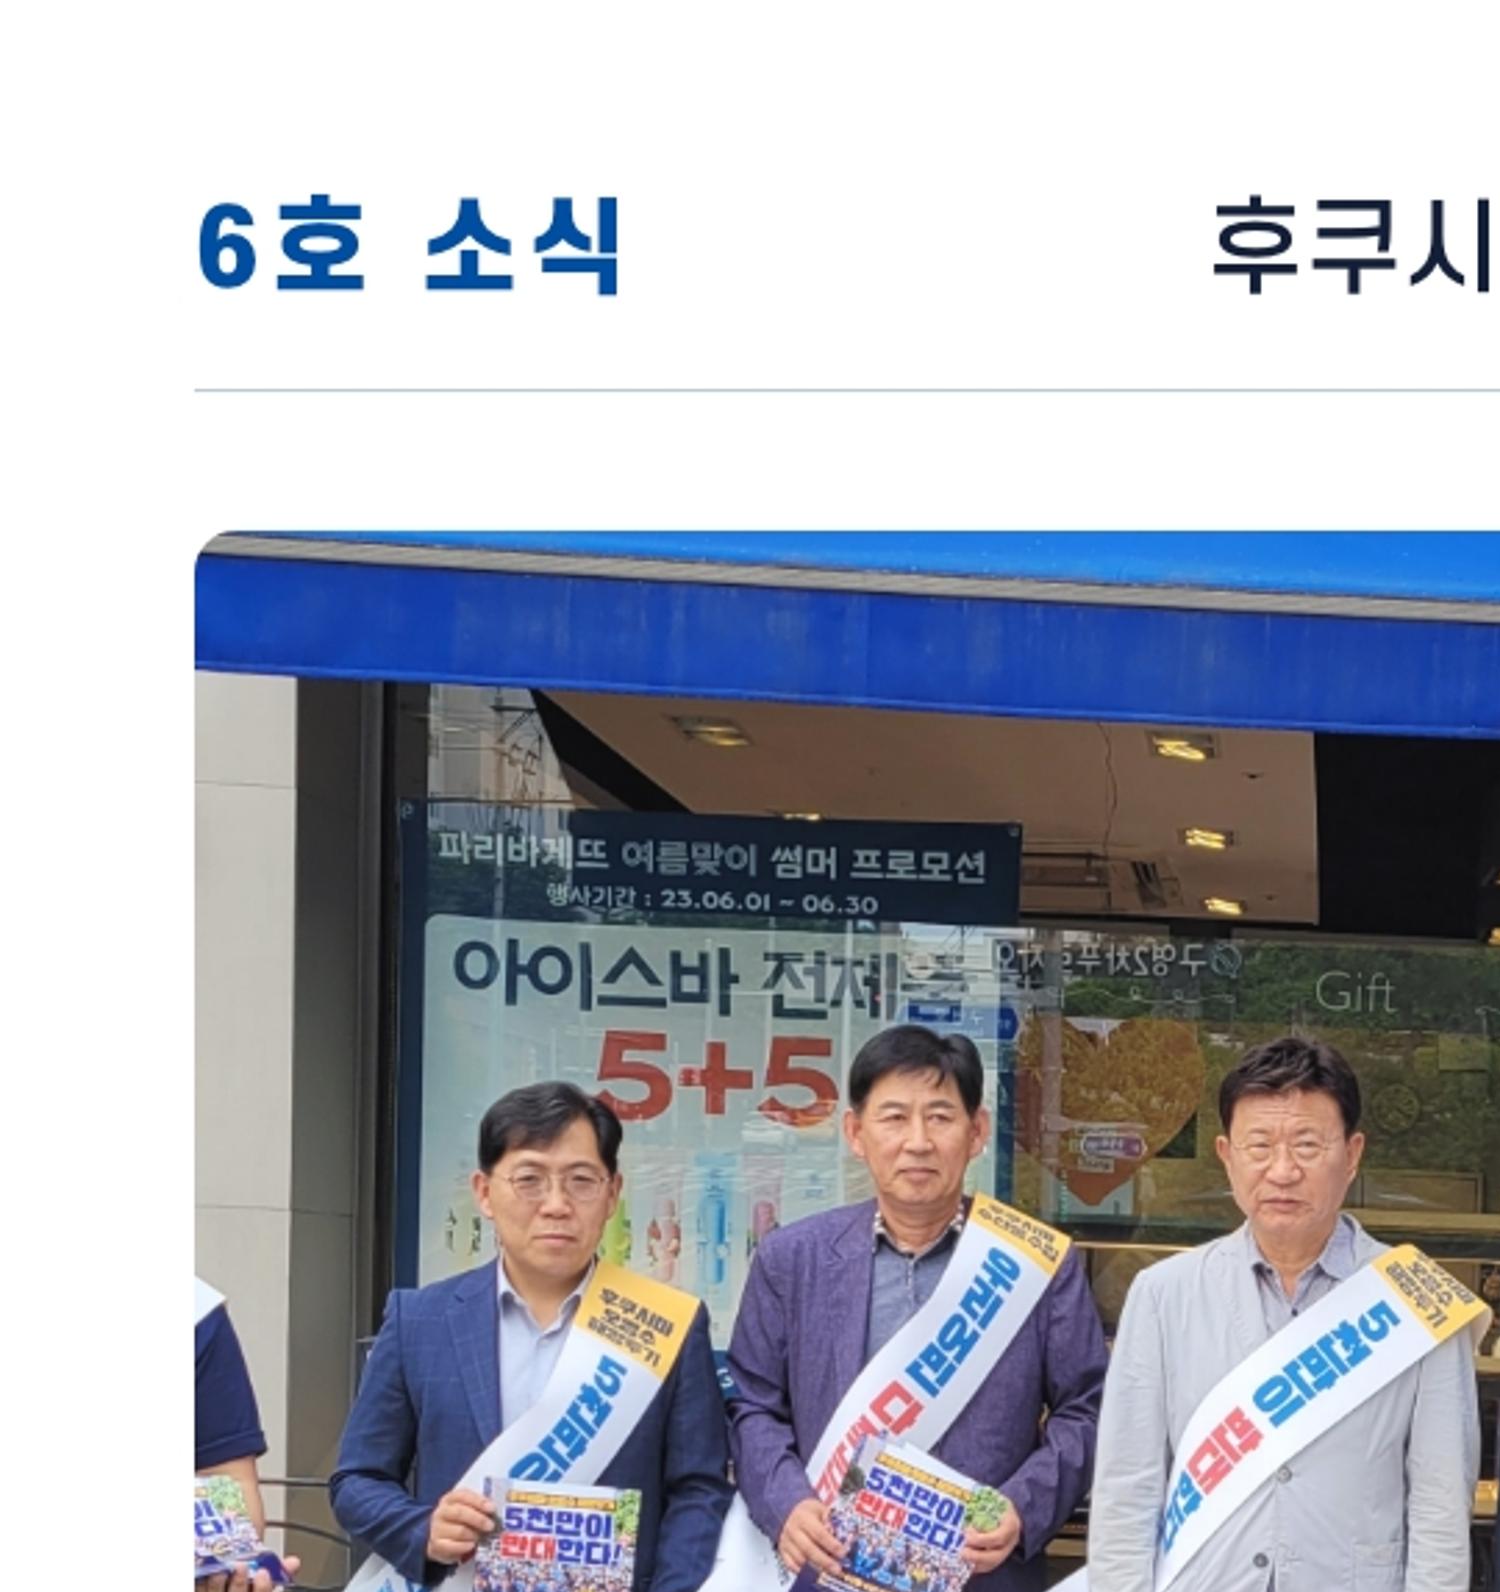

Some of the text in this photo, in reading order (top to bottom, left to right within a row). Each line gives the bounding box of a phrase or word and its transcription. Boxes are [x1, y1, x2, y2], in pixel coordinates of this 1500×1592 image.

[438, 831, 987, 885] 파리바게뜨 여름맞이 썸머 프로모션
[546, 883, 637, 909] 행사기간
[660, 891, 771, 912] 23.06.01
[802, 893, 879, 916] 06.30
[453, 938, 739, 1017] 아이스바
[1314, 969, 1397, 1016] Gift
[597, 1030, 839, 1128] 5+5
[1252, 1300, 1402, 1429] 5천만이
[504, 1506, 614, 1539] 5천만이
[866, 1466, 966, 1526] 5천만이
